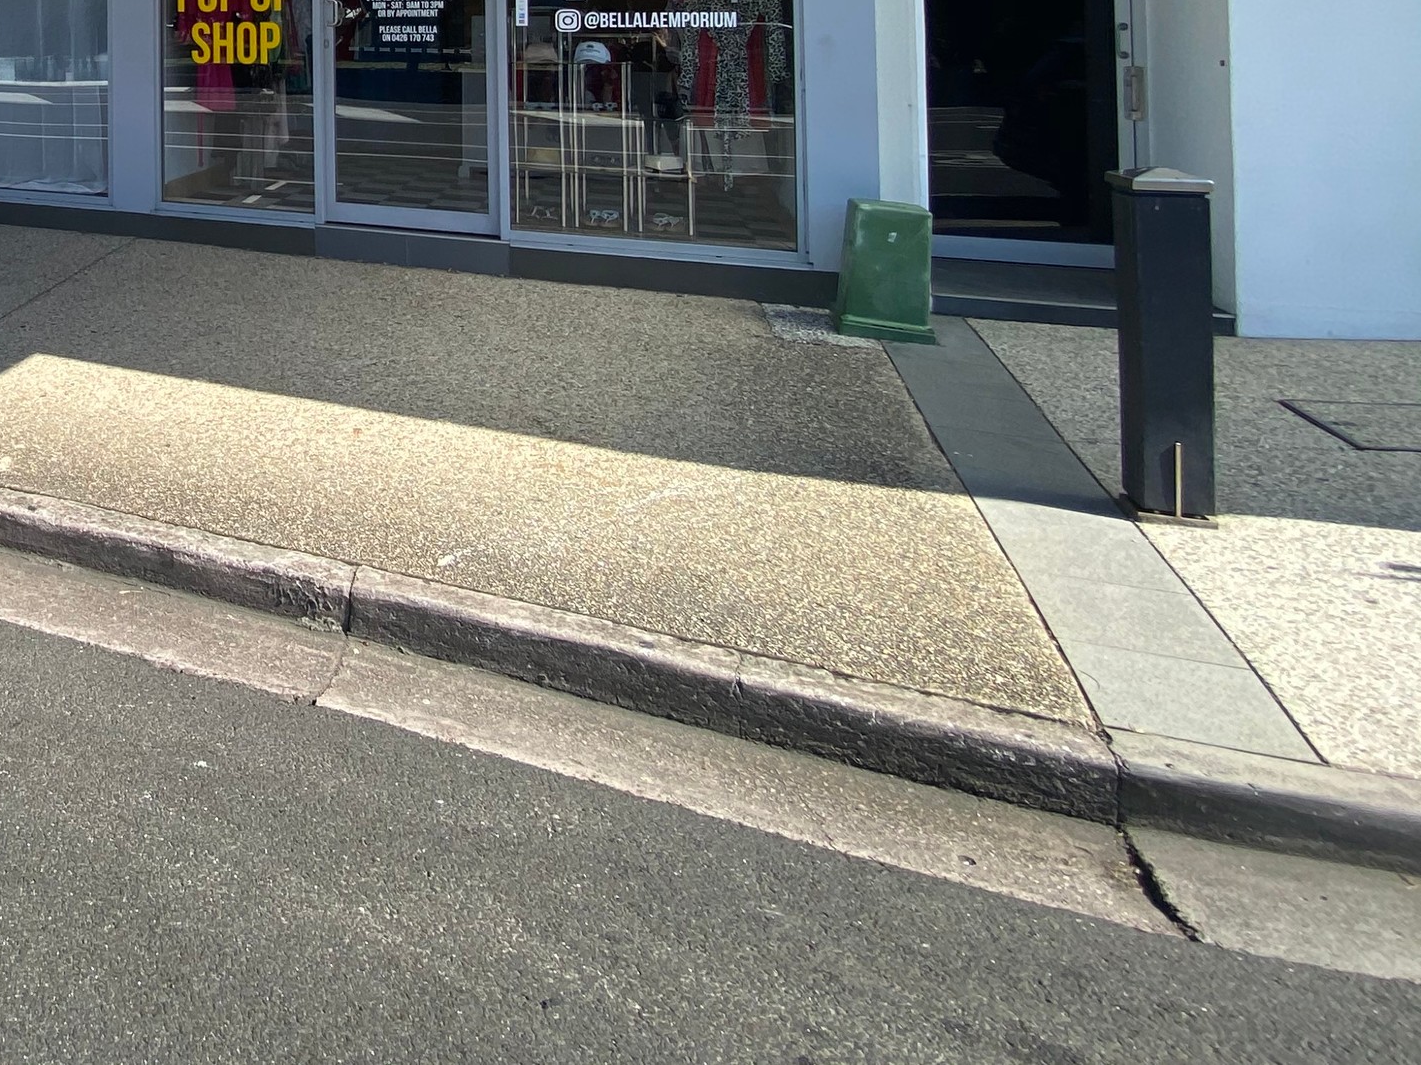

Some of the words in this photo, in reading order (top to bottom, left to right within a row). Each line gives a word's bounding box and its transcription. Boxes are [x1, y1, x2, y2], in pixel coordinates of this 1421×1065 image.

[372, 1, 386, 9] MON
[406, 1, 420, 9] 9AM
[421, 1, 429, 9] TO
[430, 1, 444, 9] 3PM
[395, 9, 439, 17] APPOINTMENT
[584, 11, 737, 29] @BELLALAEMPORIUM
[378, 25, 401, 34] PLEASE
[402, 25, 417, 34] CALL
[418, 25, 438, 34] BELLA
[381, 34, 391, 42] ON
[392, 34, 408, 42] 0426
[409, 34, 421, 42] 170
[422, 34, 435, 42] 743
[190, 21, 281, 65] SHOP
